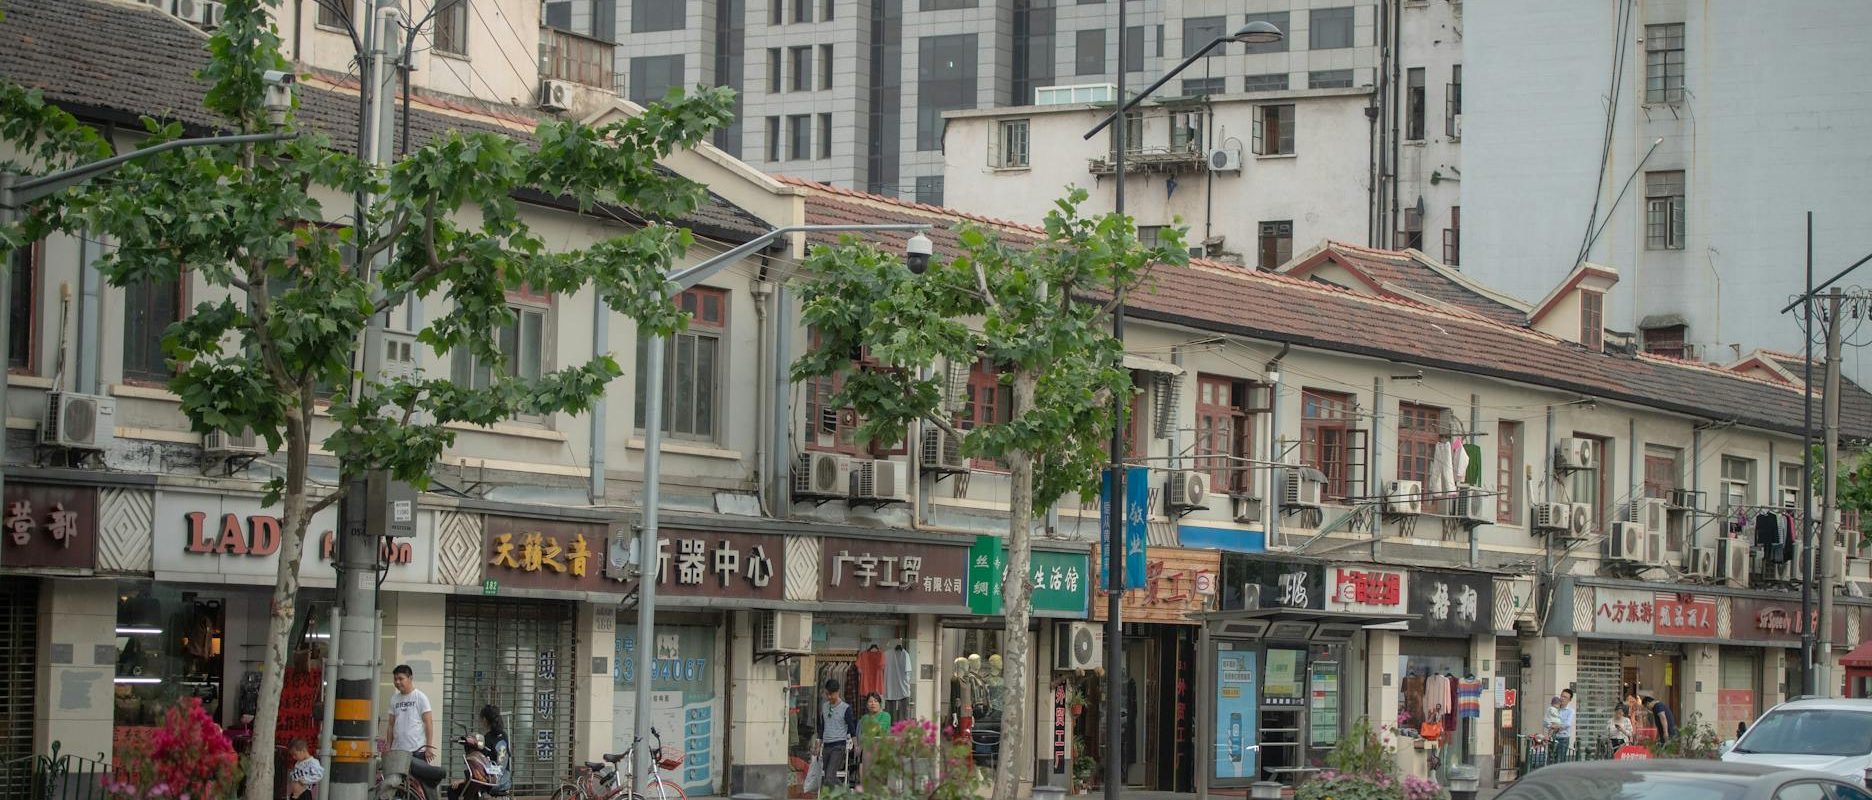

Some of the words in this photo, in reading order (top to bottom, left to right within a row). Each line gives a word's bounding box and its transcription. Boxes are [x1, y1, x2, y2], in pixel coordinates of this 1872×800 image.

[185, 511, 283, 557] LAD
[831, 550, 922, 590] 广宇工贸
[923, 576, 962, 594] 有限公司
[613, 656, 705, 682] 6394067
